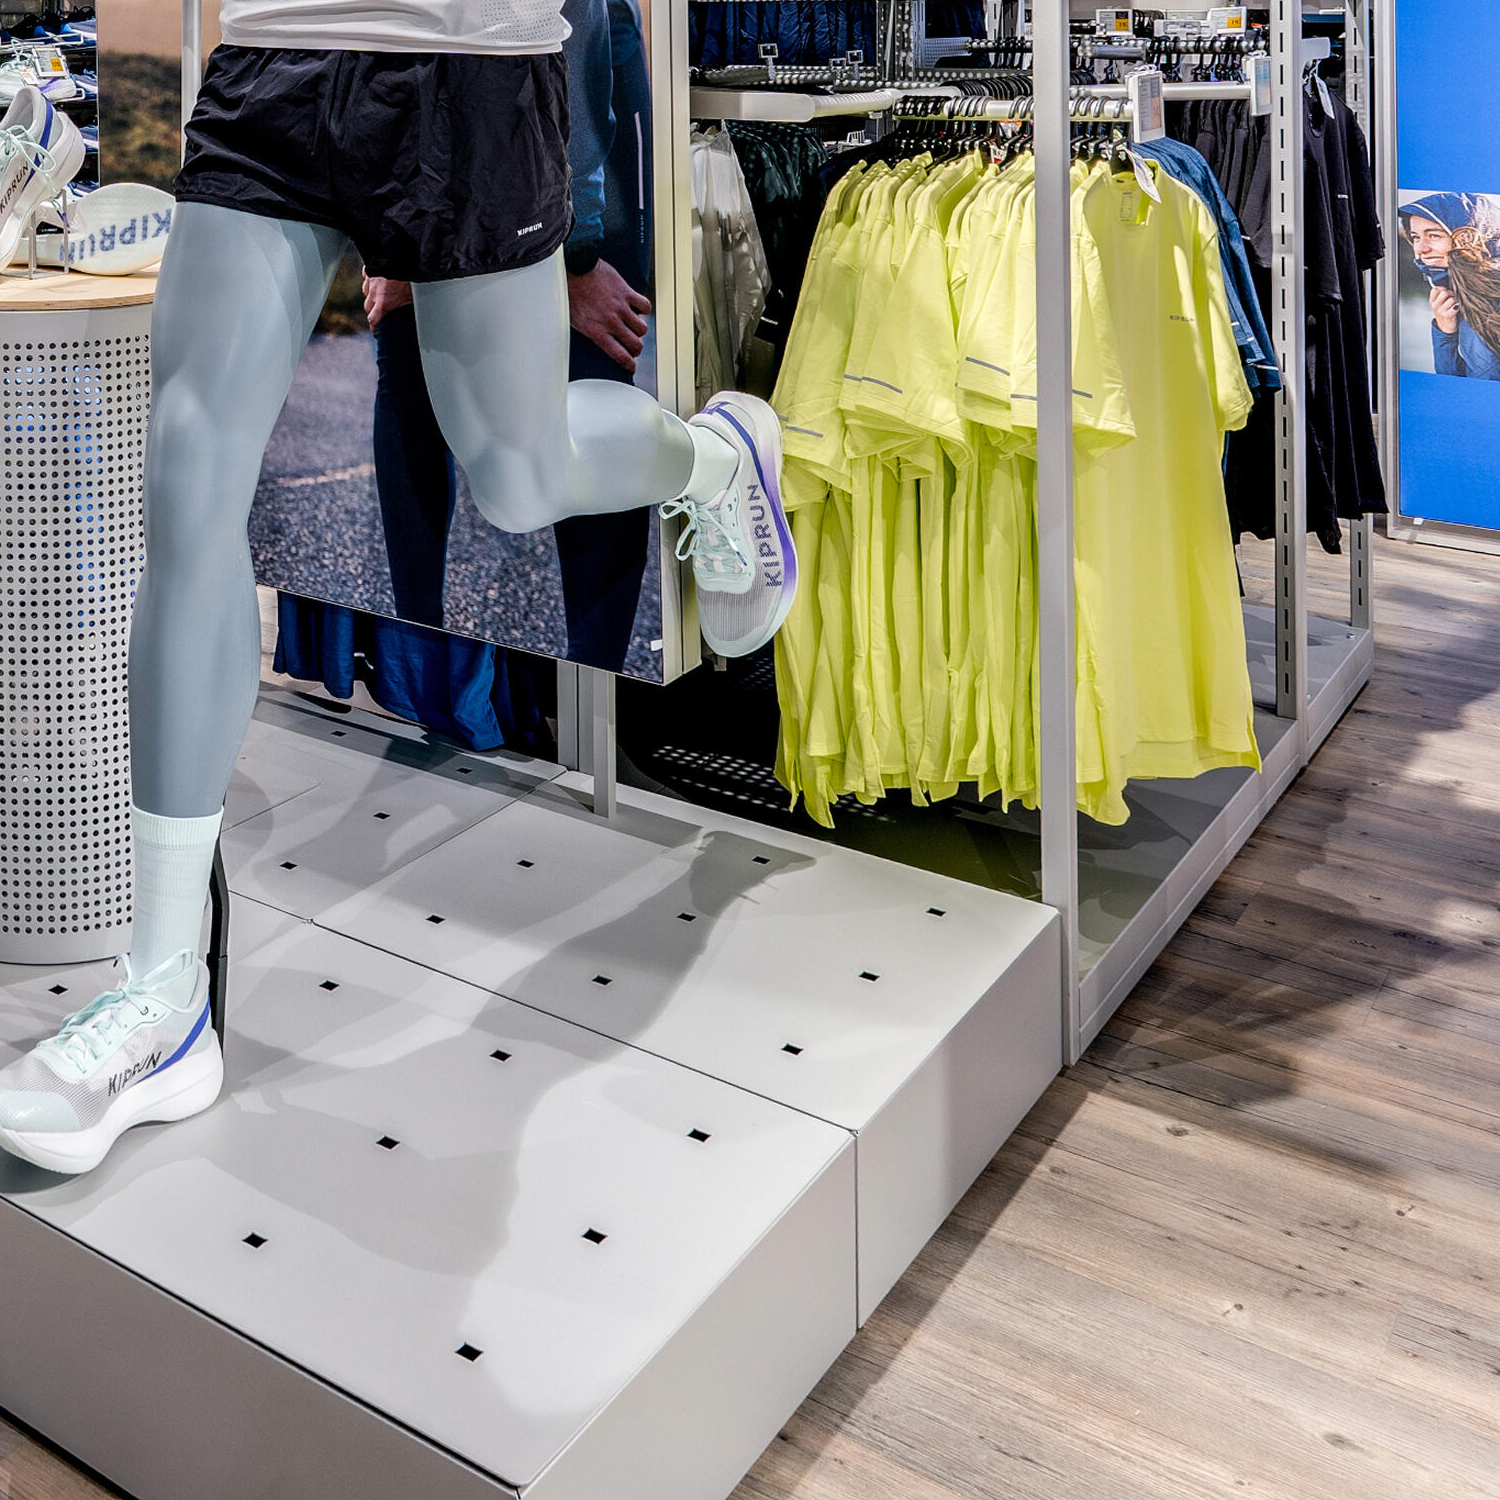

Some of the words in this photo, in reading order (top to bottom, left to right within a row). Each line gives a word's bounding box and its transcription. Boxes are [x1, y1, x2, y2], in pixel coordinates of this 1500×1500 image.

[59, 208, 172, 264] KIPRUN
[517, 222, 543, 237] KIPRUN
[747, 484, 783, 588] KIPRUN
[108, 1051, 162, 1097] KIPRUN
